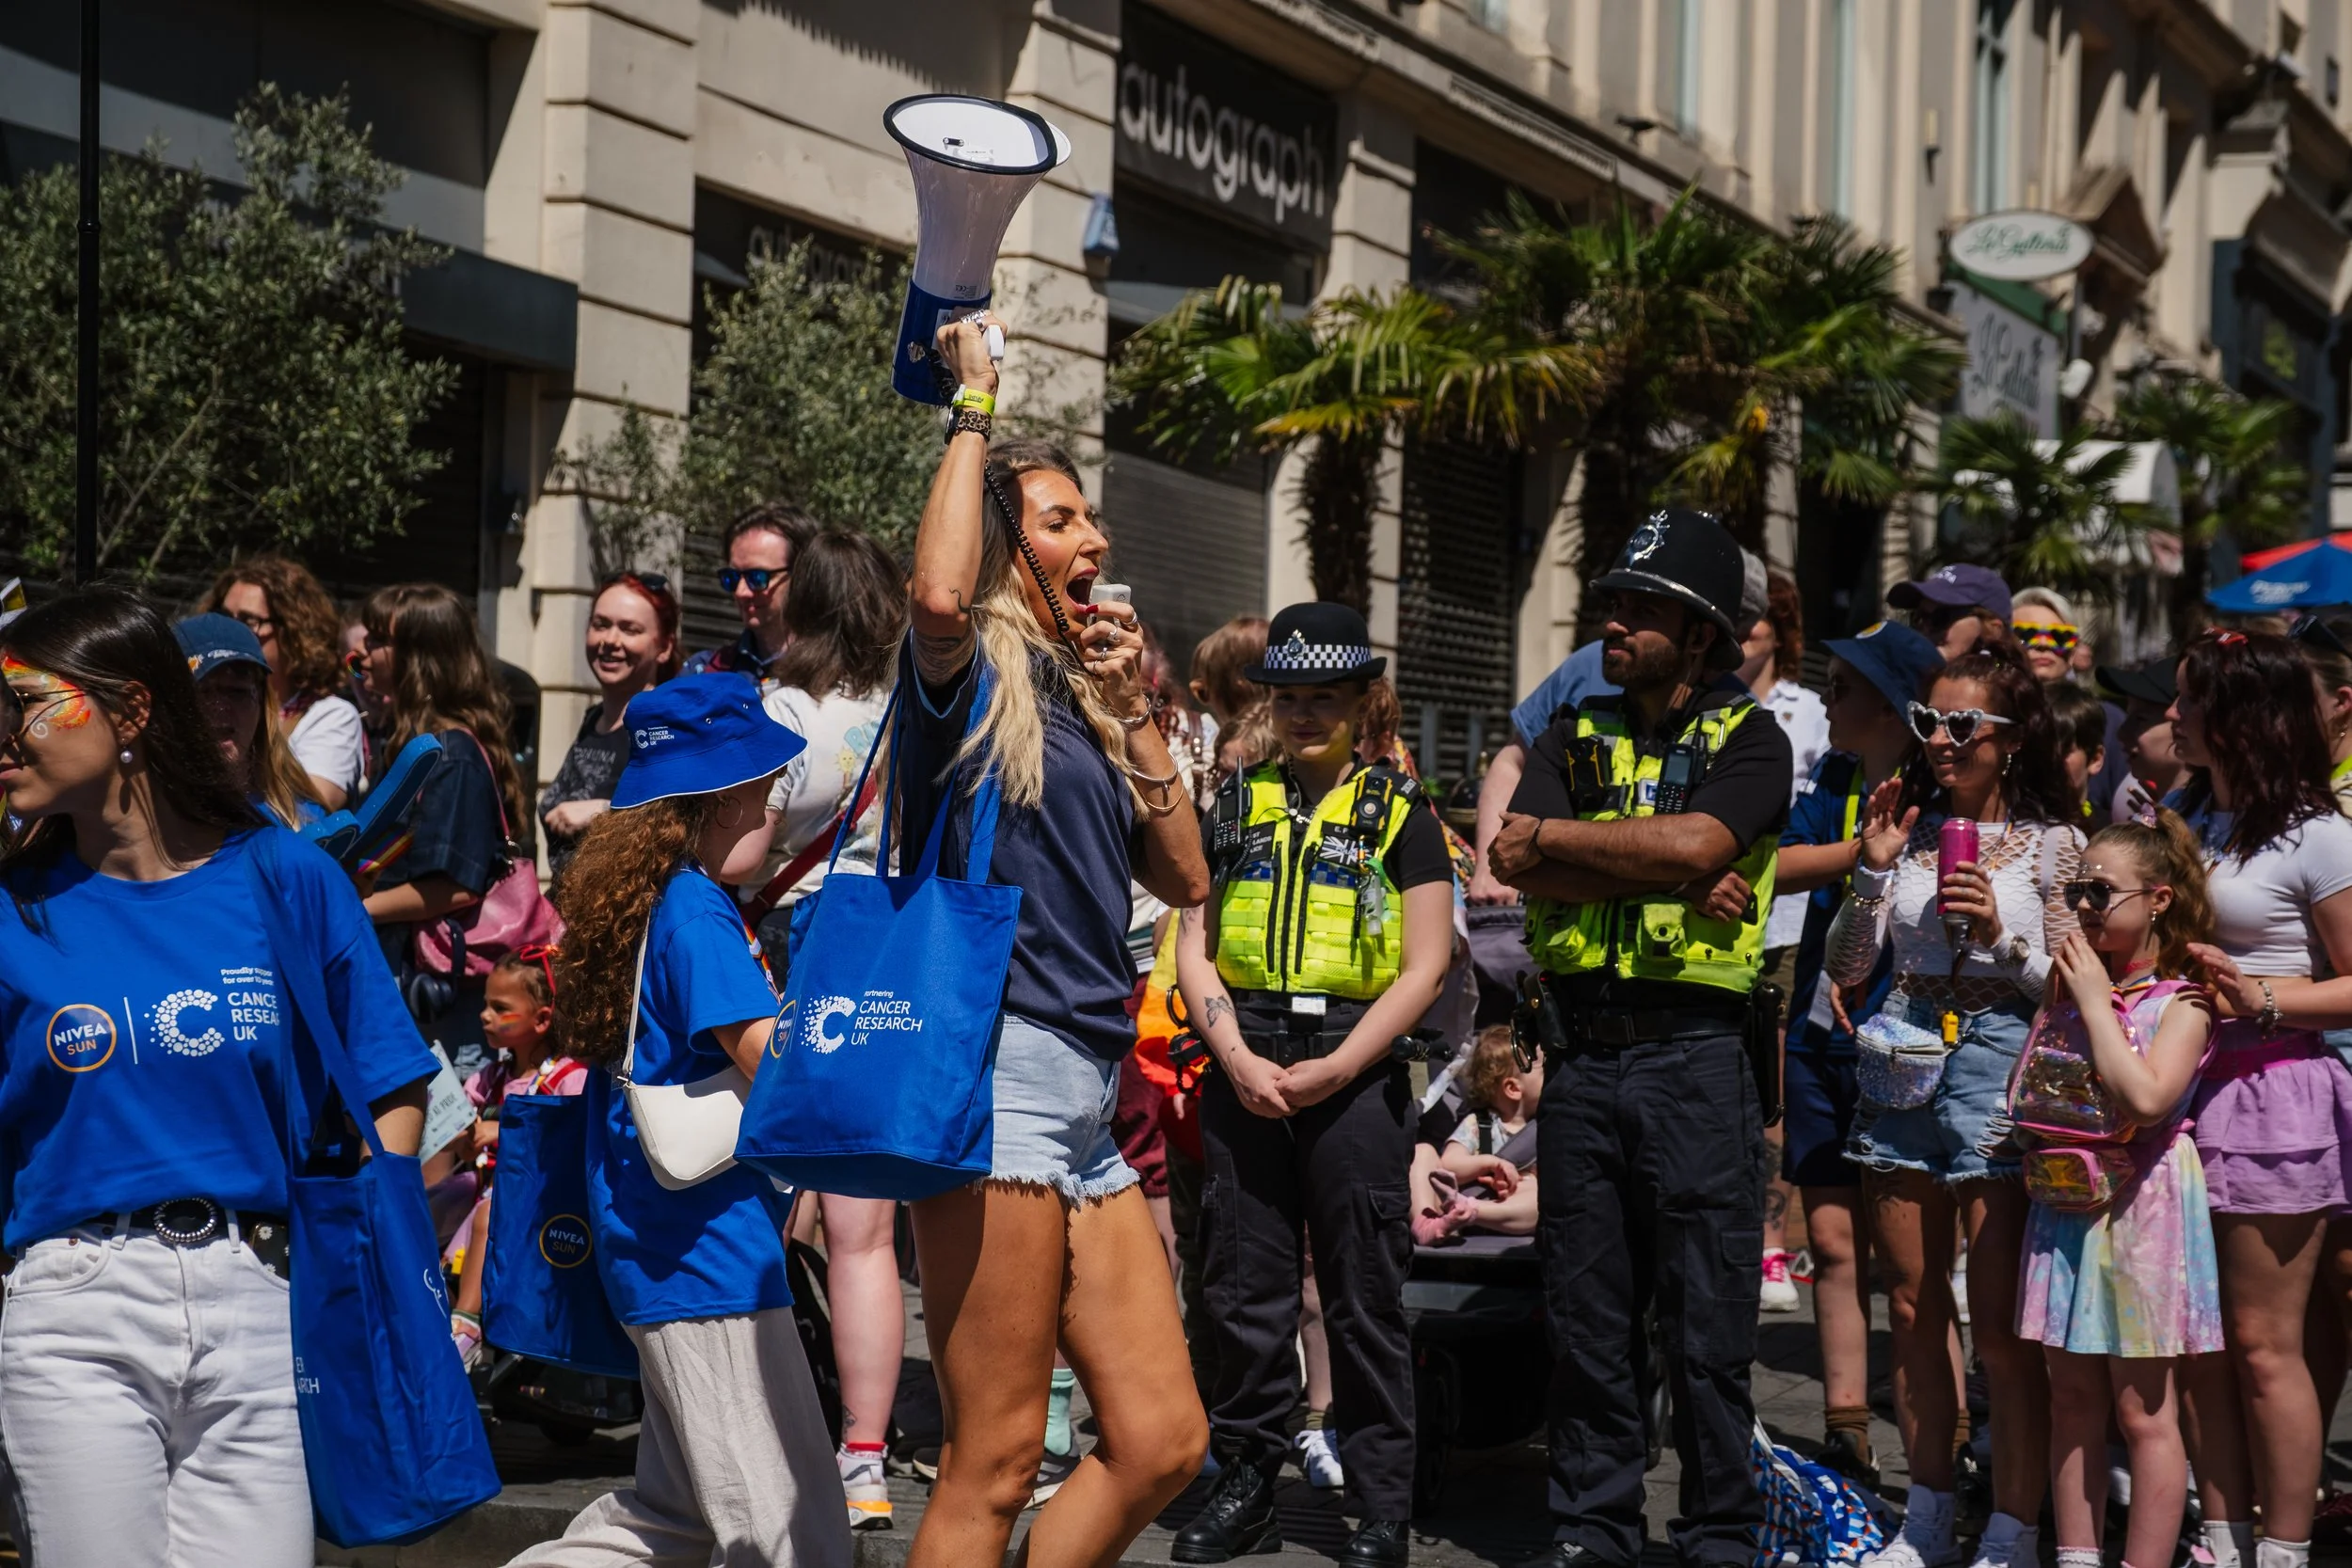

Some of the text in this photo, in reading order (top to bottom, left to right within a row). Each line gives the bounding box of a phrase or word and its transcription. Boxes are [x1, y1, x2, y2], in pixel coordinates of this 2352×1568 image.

[1120, 62, 1325, 225] autograph
[220, 967, 253, 976] Proudly
[859, 1001, 911, 1014] CANCER
[855, 1017, 923, 1032] RESEARCH
[54, 1022, 108, 1047] NIVEA
[233, 1025, 259, 1042] UK
[850, 1032, 870, 1046] UK
[67, 1038, 98, 1055] SUN
[548, 1228, 585, 1245] NIVEA
[551, 1241, 577, 1255] SUN
